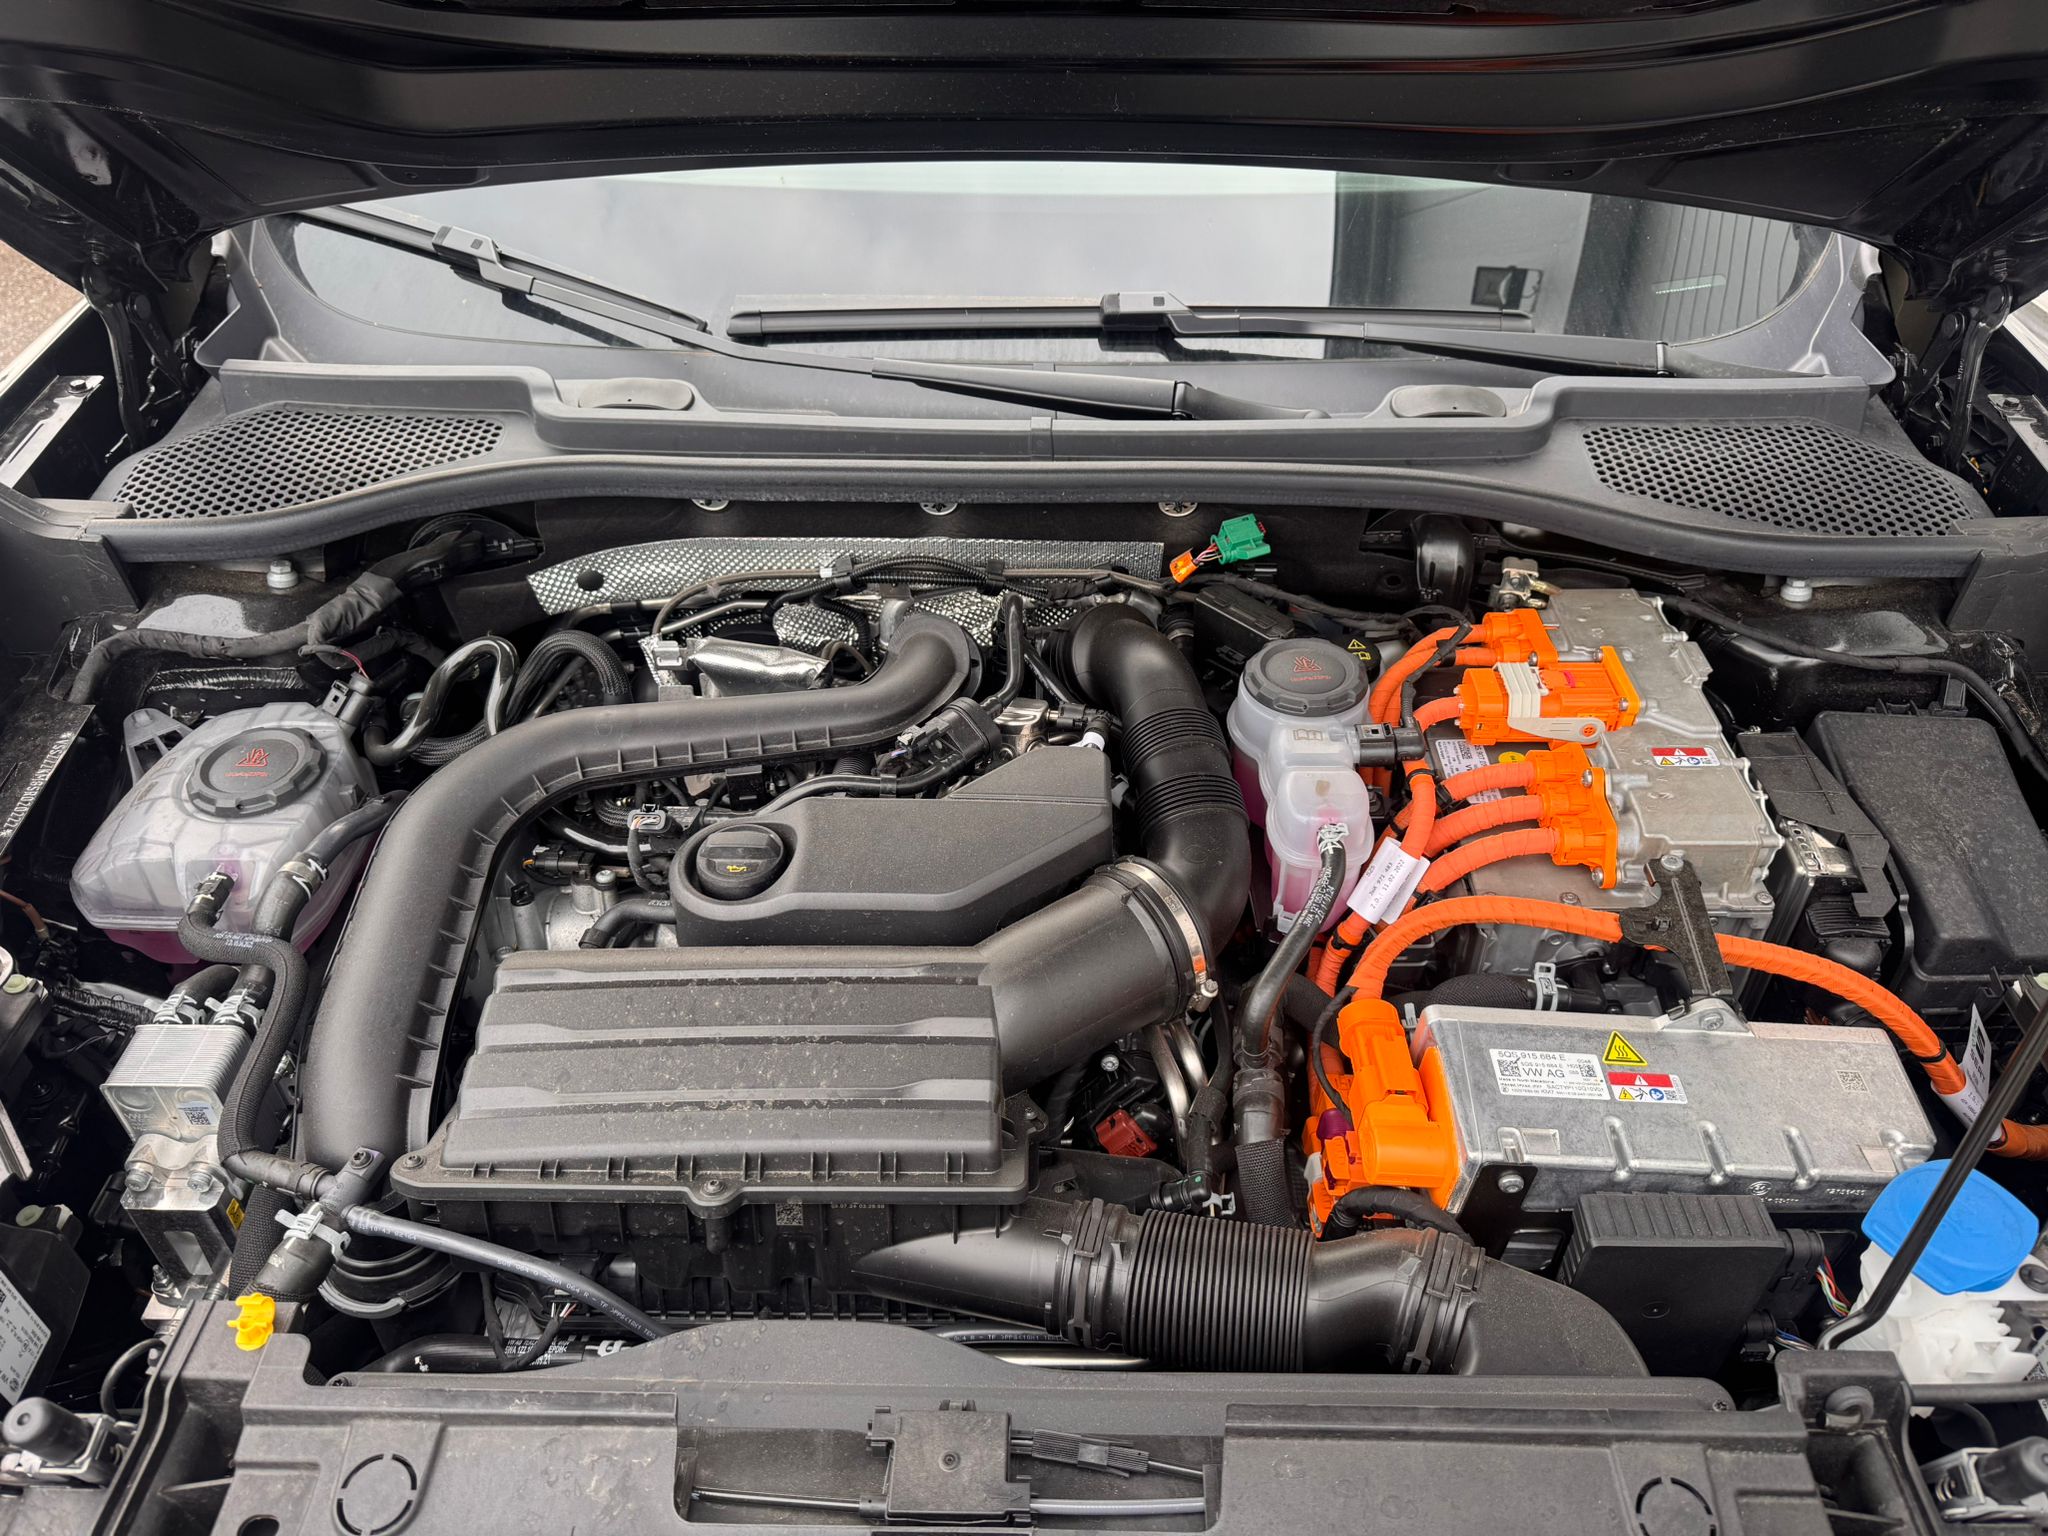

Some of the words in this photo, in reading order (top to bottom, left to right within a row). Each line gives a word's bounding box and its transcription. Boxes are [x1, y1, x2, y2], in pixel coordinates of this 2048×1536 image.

[1520, 1051, 1538, 1060] 915
[1559, 1053, 1567, 1061] E
[1522, 1067, 1543, 1076] VW
[1547, 1069, 1566, 1078] AG
[548, 1345, 568, 1354] EPDM<
